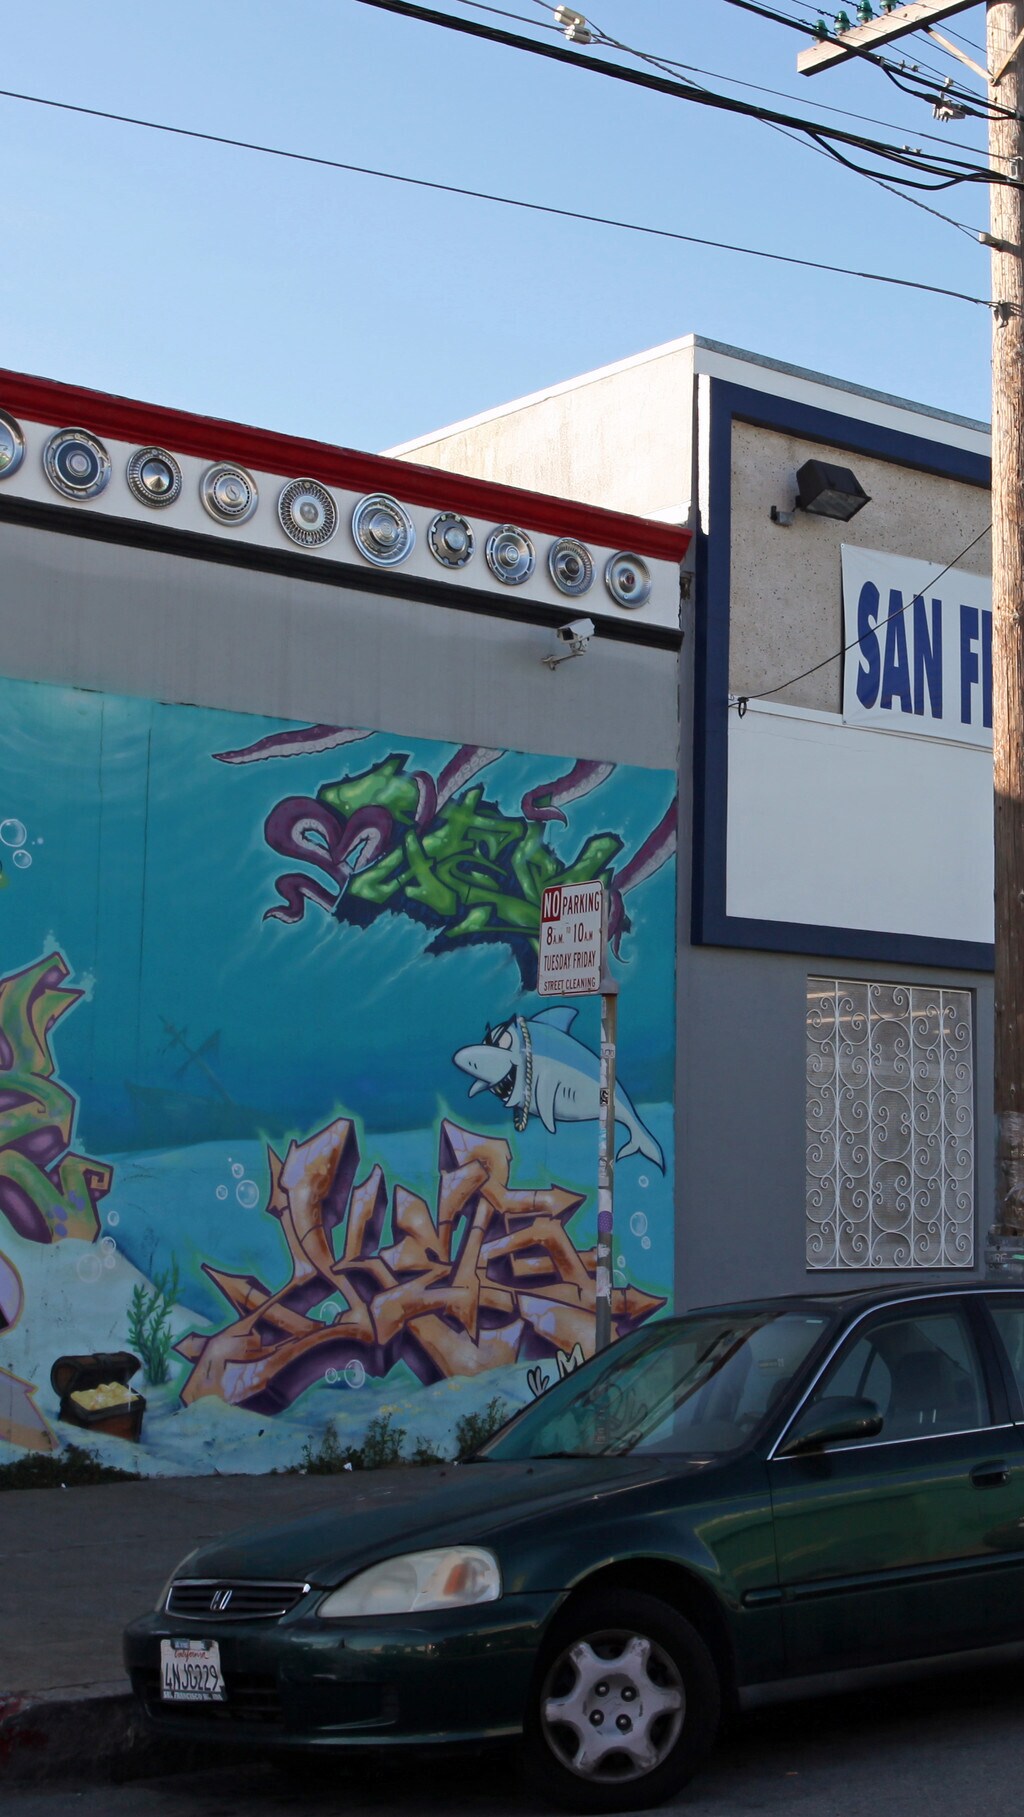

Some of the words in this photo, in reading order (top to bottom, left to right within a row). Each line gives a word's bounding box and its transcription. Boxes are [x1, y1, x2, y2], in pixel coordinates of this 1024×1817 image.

[856, 581, 942, 719] SAN
[543, 890, 560, 919] NO
[562, 891, 600, 916] PARKING
[544, 953, 572, 972] TUESDAY
[573, 950, 596, 969] FRIDAY
[544, 979, 564, 991] STREET
[566, 977, 596, 990] CLEANING
[165, 1662, 218, 1691] 4NJG229
